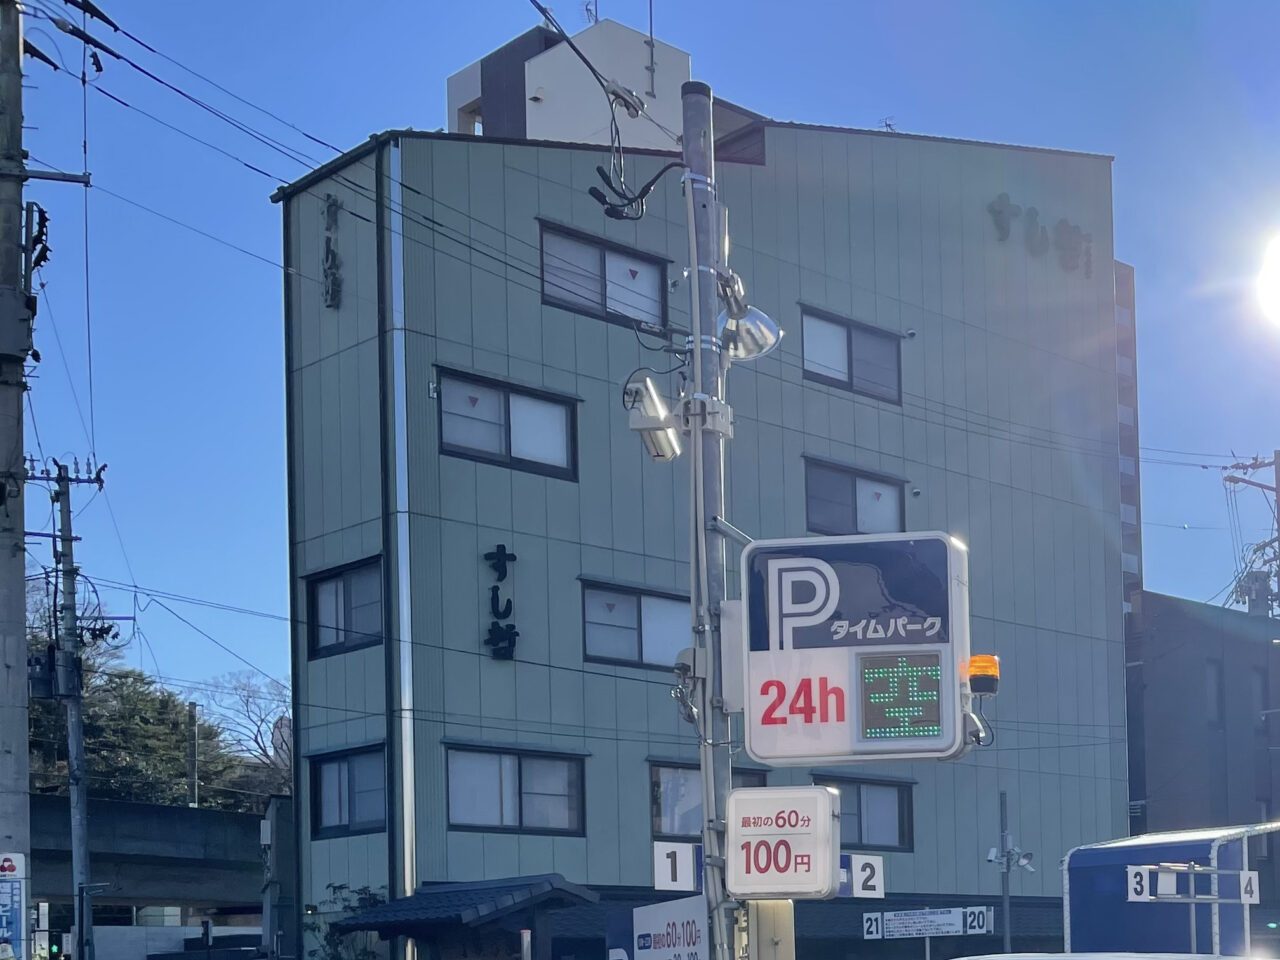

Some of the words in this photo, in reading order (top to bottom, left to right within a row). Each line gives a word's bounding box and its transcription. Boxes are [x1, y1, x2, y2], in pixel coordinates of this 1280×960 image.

[768, 558, 840, 650] P
[830, 616, 942, 640] タイムパーク
[760, 677, 845, 725] 24h
[863, 656, 942, 738] 空
[741, 810, 811, 828] 最初の60分
[666, 851, 678, 882] 1
[741, 839, 811, 874] 100円
[860, 862, 876, 891] 2
[1133, 872, 1144, 896] 3
[1243, 877, 1254, 898] 4
[865, 917, 879, 935] 21
[968, 911, 985, 930] 20
